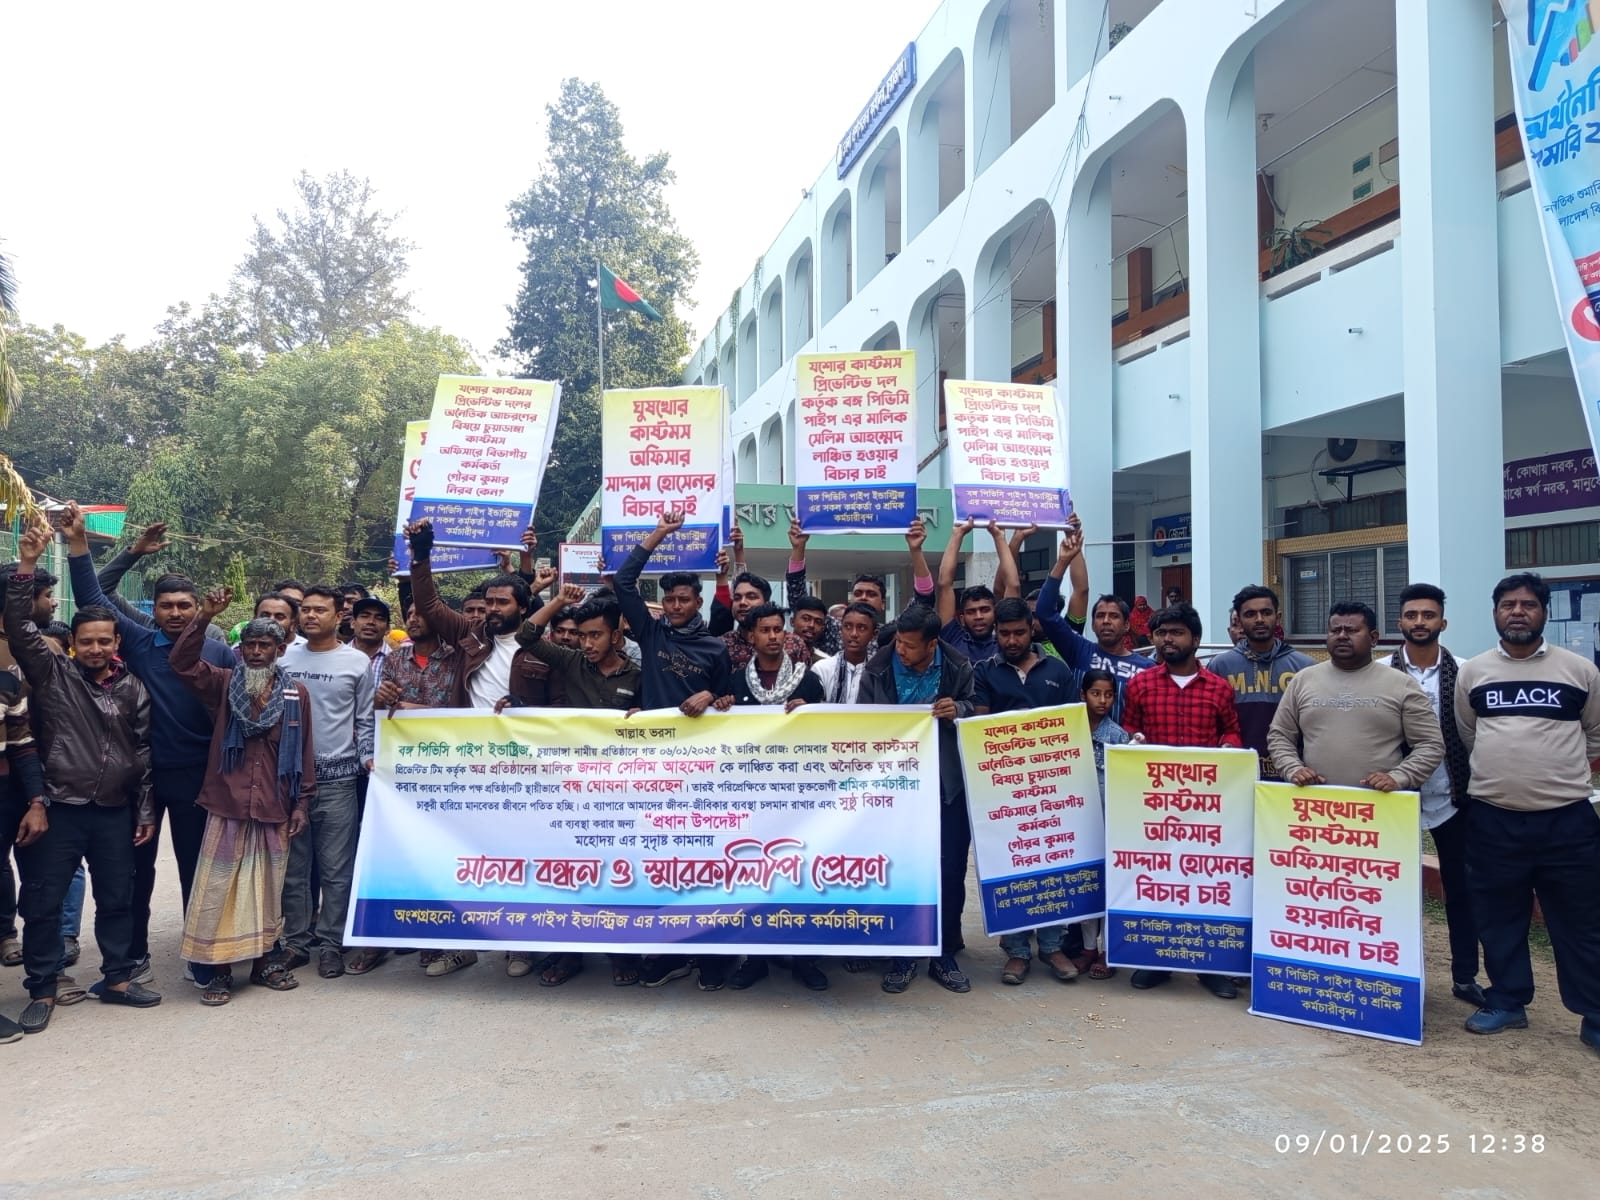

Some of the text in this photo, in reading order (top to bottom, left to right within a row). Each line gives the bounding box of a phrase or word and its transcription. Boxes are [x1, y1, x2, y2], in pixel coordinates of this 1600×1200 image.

[809, 360, 846, 374] যশোর
[814, 373, 897, 392] প্রিভেন্টিভ দল
[505, 400, 531, 409] দলের
[633, 399, 688, 422] ঘুষখোর
[802, 391, 910, 412] কর্তৃক বঙ্গ পিভিসি
[804, 409, 907, 427] পাইপ এর মালিক
[808, 430, 903, 447] সেলিম আহম্মেদ
[957, 426, 1054, 442] পাইপ এর মালিক
[486, 448, 527, 460] বিভাগীয়
[630, 444, 691, 467] অফিসার
[857, 448, 898, 463] হওয়ার
[461, 459, 501, 471] কর্মকর্তা
[824, 465, 887, 482] বিচার চাই
[480, 474, 509, 486] কুমার
[605, 473, 716, 493] সাদ্দাম হোসেনর
[981, 468, 1040, 483] বিচার চাই
[446, 485, 504, 497] নিরব কেন?
[622, 495, 697, 518] বিচার চাই
[1486, 687, 1562, 709] BLACK
[649, 727, 676, 739] ভরসা
[984, 724, 1017, 737] যশোর
[418, 742, 450, 757] পিভিসি
[456, 742, 483, 757] পাইপ
[601, 745, 638, 756] প্রতিষ্ঠানে
[660, 746, 716, 756] ০৬/০১/২০২৫
[736, 743, 760, 754] তারিখ
[794, 744, 828, 754] সোমবার
[832, 741, 866, 753] যশোর
[984, 733, 1069, 755] প্রিভেন্টিভ দলের
[490, 760, 536, 774] প্রতিষ্ঠানের
[542, 761, 572, 774] মালিক
[578, 760, 612, 774] জনাব
[618, 758, 657, 774] সেলিম
[720, 762, 734, 773] কে
[778, 762, 798, 772] করা
[803, 762, 825, 772] এবং
[829, 759, 874, 772] অনৈতিক
[898, 758, 920, 772] দাবি
[977, 747, 1081, 773] অনৈতিক আচরণের
[395, 776, 920, 794] করার মালিক প্রতিষ্ঠানটি বন্ধ ঘোষনা আমরা শ্রমিক কর্মচারীরা
[992, 765, 1071, 787] বিষয়ে চুয়াডাঙ্গা
[1146, 762, 1218, 789] ঘুষখোর
[466, 802, 500, 810] মানবেতর
[502, 799, 527, 810] জীবনে
[594, 802, 624, 811] ব্যাপারে
[627, 802, 663, 811] আমাদের
[760, 800, 788, 810] চলমান
[818, 801, 837, 810] এবং
[862, 792, 895, 808] বিচার
[988, 795, 1084, 821] অফিসারে বিভাগীয়
[1292, 798, 1375, 823] ঘুষখোর
[550, 820, 562, 829] এর
[592, 820, 614, 829] করার
[1018, 815, 1062, 833] কর্মকর্তা
[1144, 816, 1222, 847] অফিসার
[575, 834, 715, 848] মহোদয় এর কামনায়
[1008, 831, 1075, 853] গৌরব কুমার
[457, 839, 888, 891] মানব বন্ধন ও স্মারকলিপি প্রেরণ
[1012, 849, 1075, 868] নিরব কেন?
[1113, 851, 1254, 879] সাদ্দাম হোসেনর
[1269, 845, 1401, 882] অফিসারদের
[1136, 874, 1231, 906] বিচার চাই
[1285, 876, 1382, 905] অনৈতিক
[461, 907, 504, 925] মেসার্স
[506, 912, 526, 926] বঙ্গ
[531, 910, 567, 927] পাইপ
[633, 914, 652, 928] এর
[659, 915, 692, 928] সকল
[696, 910, 744, 929] কর্মকর্তা
[752, 916, 762, 928] ও
[767, 909, 806, 928] শ্রমিক
[811, 910, 884, 934] কর্মচারীবৃন্দ
[1285, 904, 1382, 936] হয়রানির
[1270, 930, 1399, 966] অবসান চাই
[1267, 965, 1283, 977] বঙ্গ
[1286, 966, 1320, 984] পিভিসি
[1323, 974, 1351, 988] পাইপ
[1268, 980, 1402, 1011] এর সকল কর্মকর্তা ও শ্রমিক
